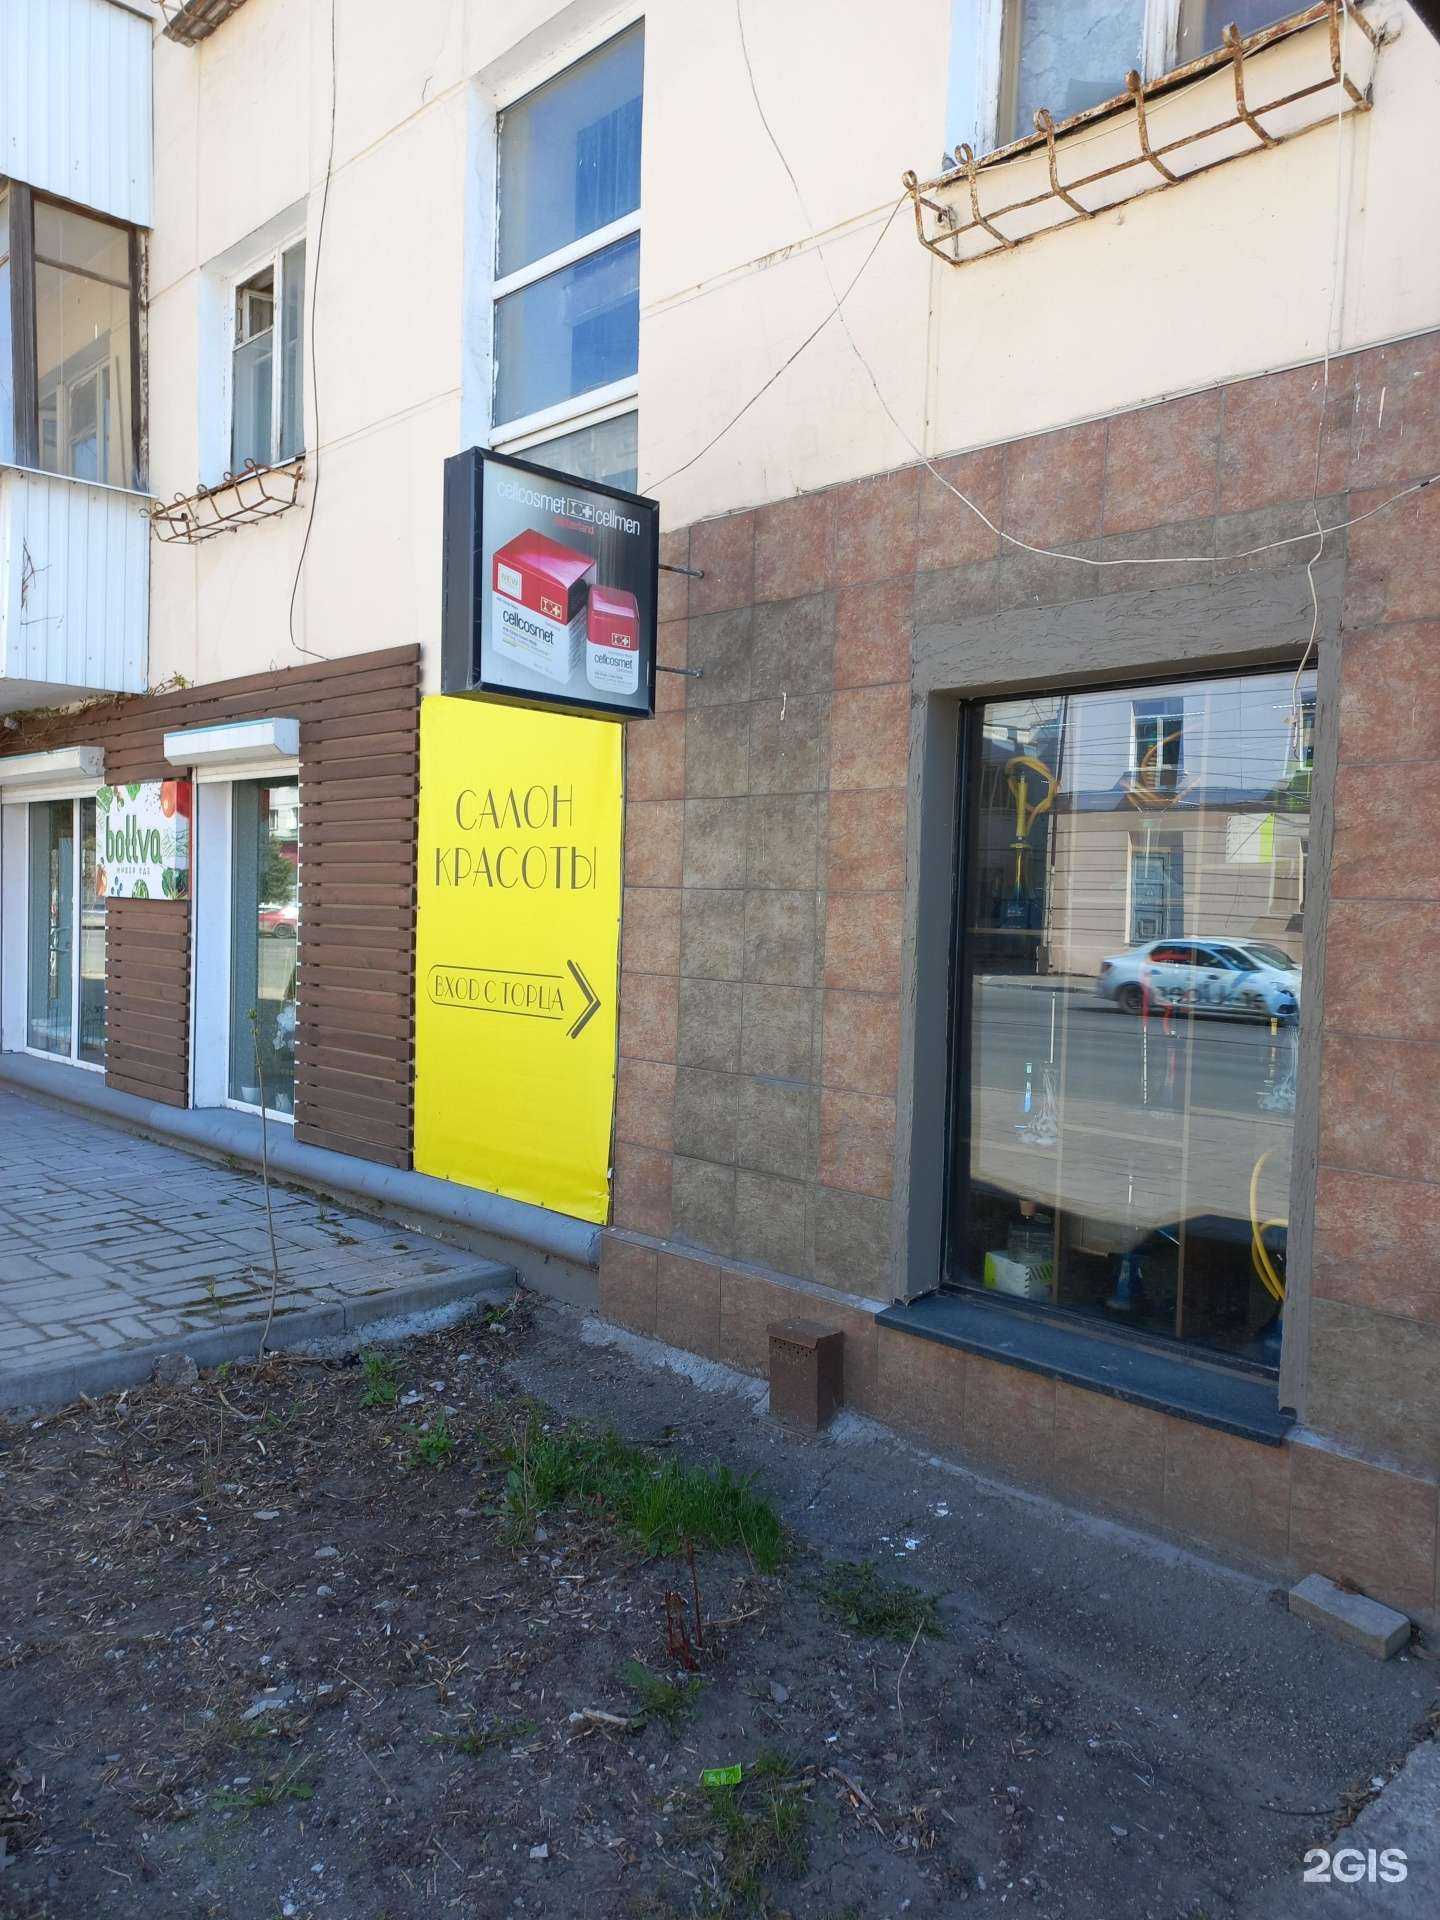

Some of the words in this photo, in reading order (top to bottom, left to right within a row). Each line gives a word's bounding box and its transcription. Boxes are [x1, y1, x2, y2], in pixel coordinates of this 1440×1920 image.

[496, 481, 567, 516] cellcosmet
[595, 508, 641, 536] cellmen
[502, 610, 555, 645] cellcosmet
[594, 654, 633, 670] cellcosmet
[455, 784, 573, 831] САЛОН
[435, 845, 597, 890] КРАСОТЫ
[434, 975, 480, 1001] ВХОД
[500, 981, 565, 1012] ТОРЦА
